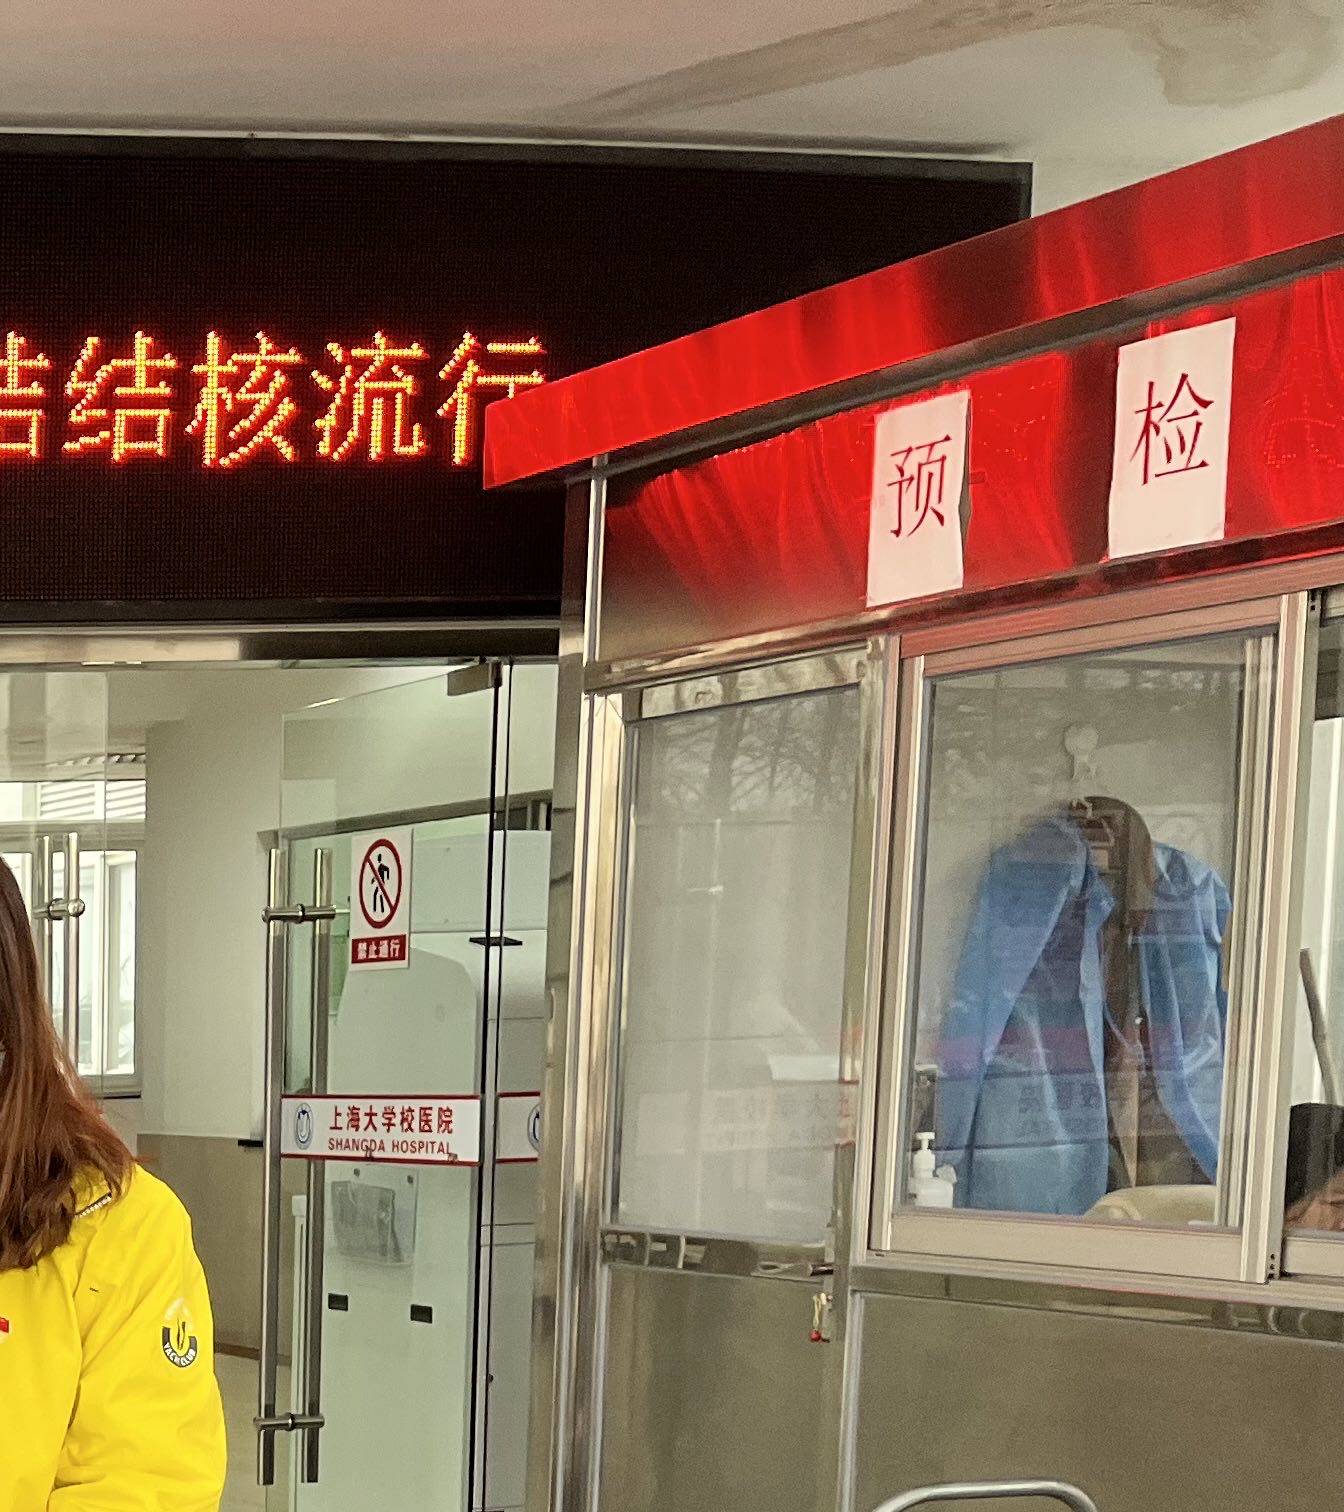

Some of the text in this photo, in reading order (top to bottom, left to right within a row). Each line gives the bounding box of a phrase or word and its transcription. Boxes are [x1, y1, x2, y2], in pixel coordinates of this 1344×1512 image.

[356, 938, 401, 961] 禁止通行
[328, 1104, 454, 1135] 上海大学校医院
[327, 1136, 453, 1156] SHANGDA HOSPITAL
